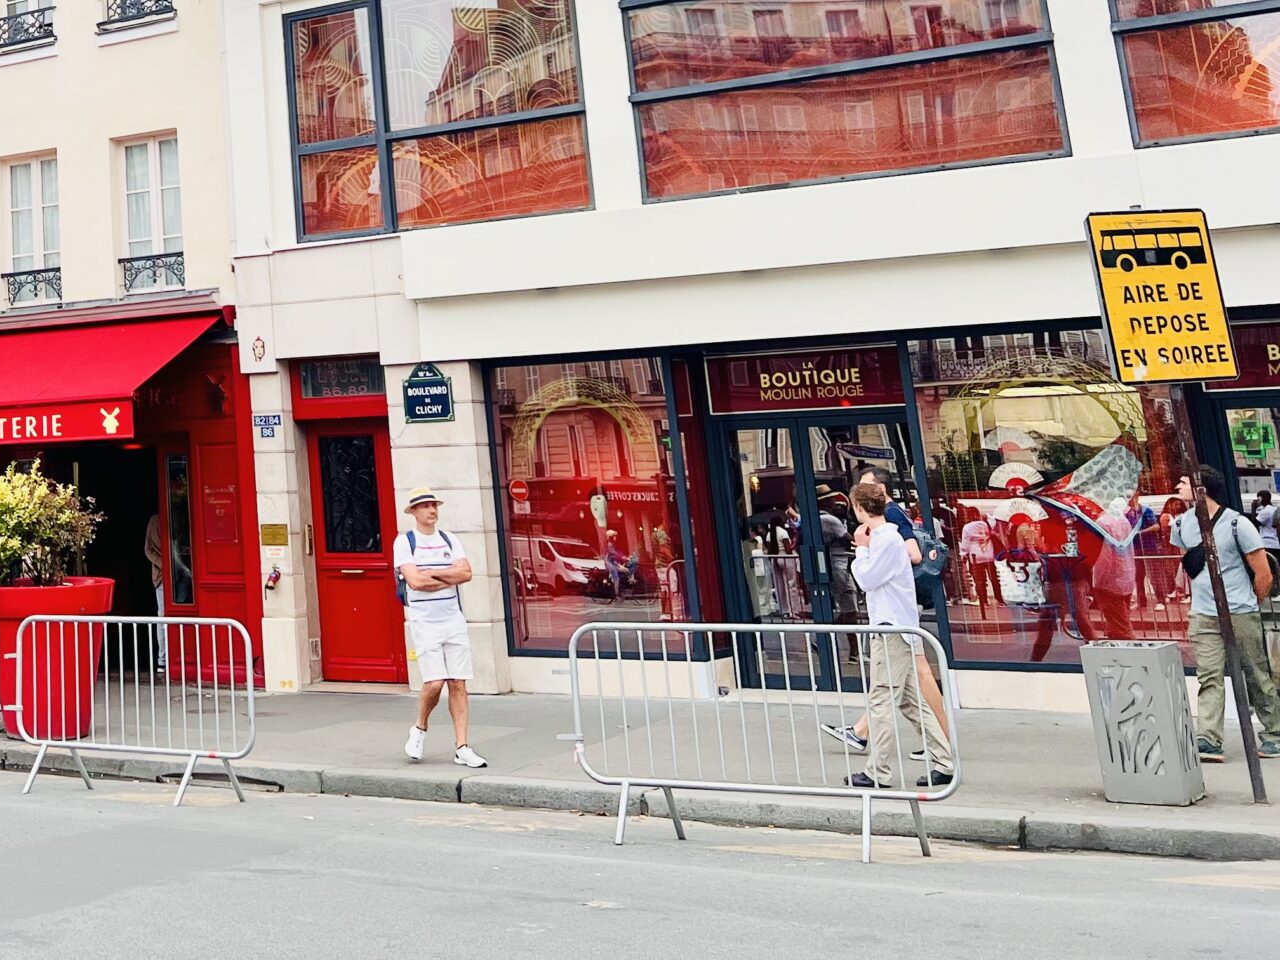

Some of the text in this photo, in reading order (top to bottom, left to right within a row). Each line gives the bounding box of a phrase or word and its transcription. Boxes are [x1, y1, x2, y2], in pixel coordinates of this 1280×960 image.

[1123, 281, 1203, 304] AIRE DE
[1129, 312, 1210, 335] DEPOSE
[1158, 344, 1229, 365] SOIREE
[802, 361, 814, 369] LA
[760, 368, 861, 388] BOUTIQUE
[407, 385, 448, 397] BOULEVARD
[760, 385, 865, 401] MOULIN ROUGE
[415, 405, 443, 415] CLICHY
